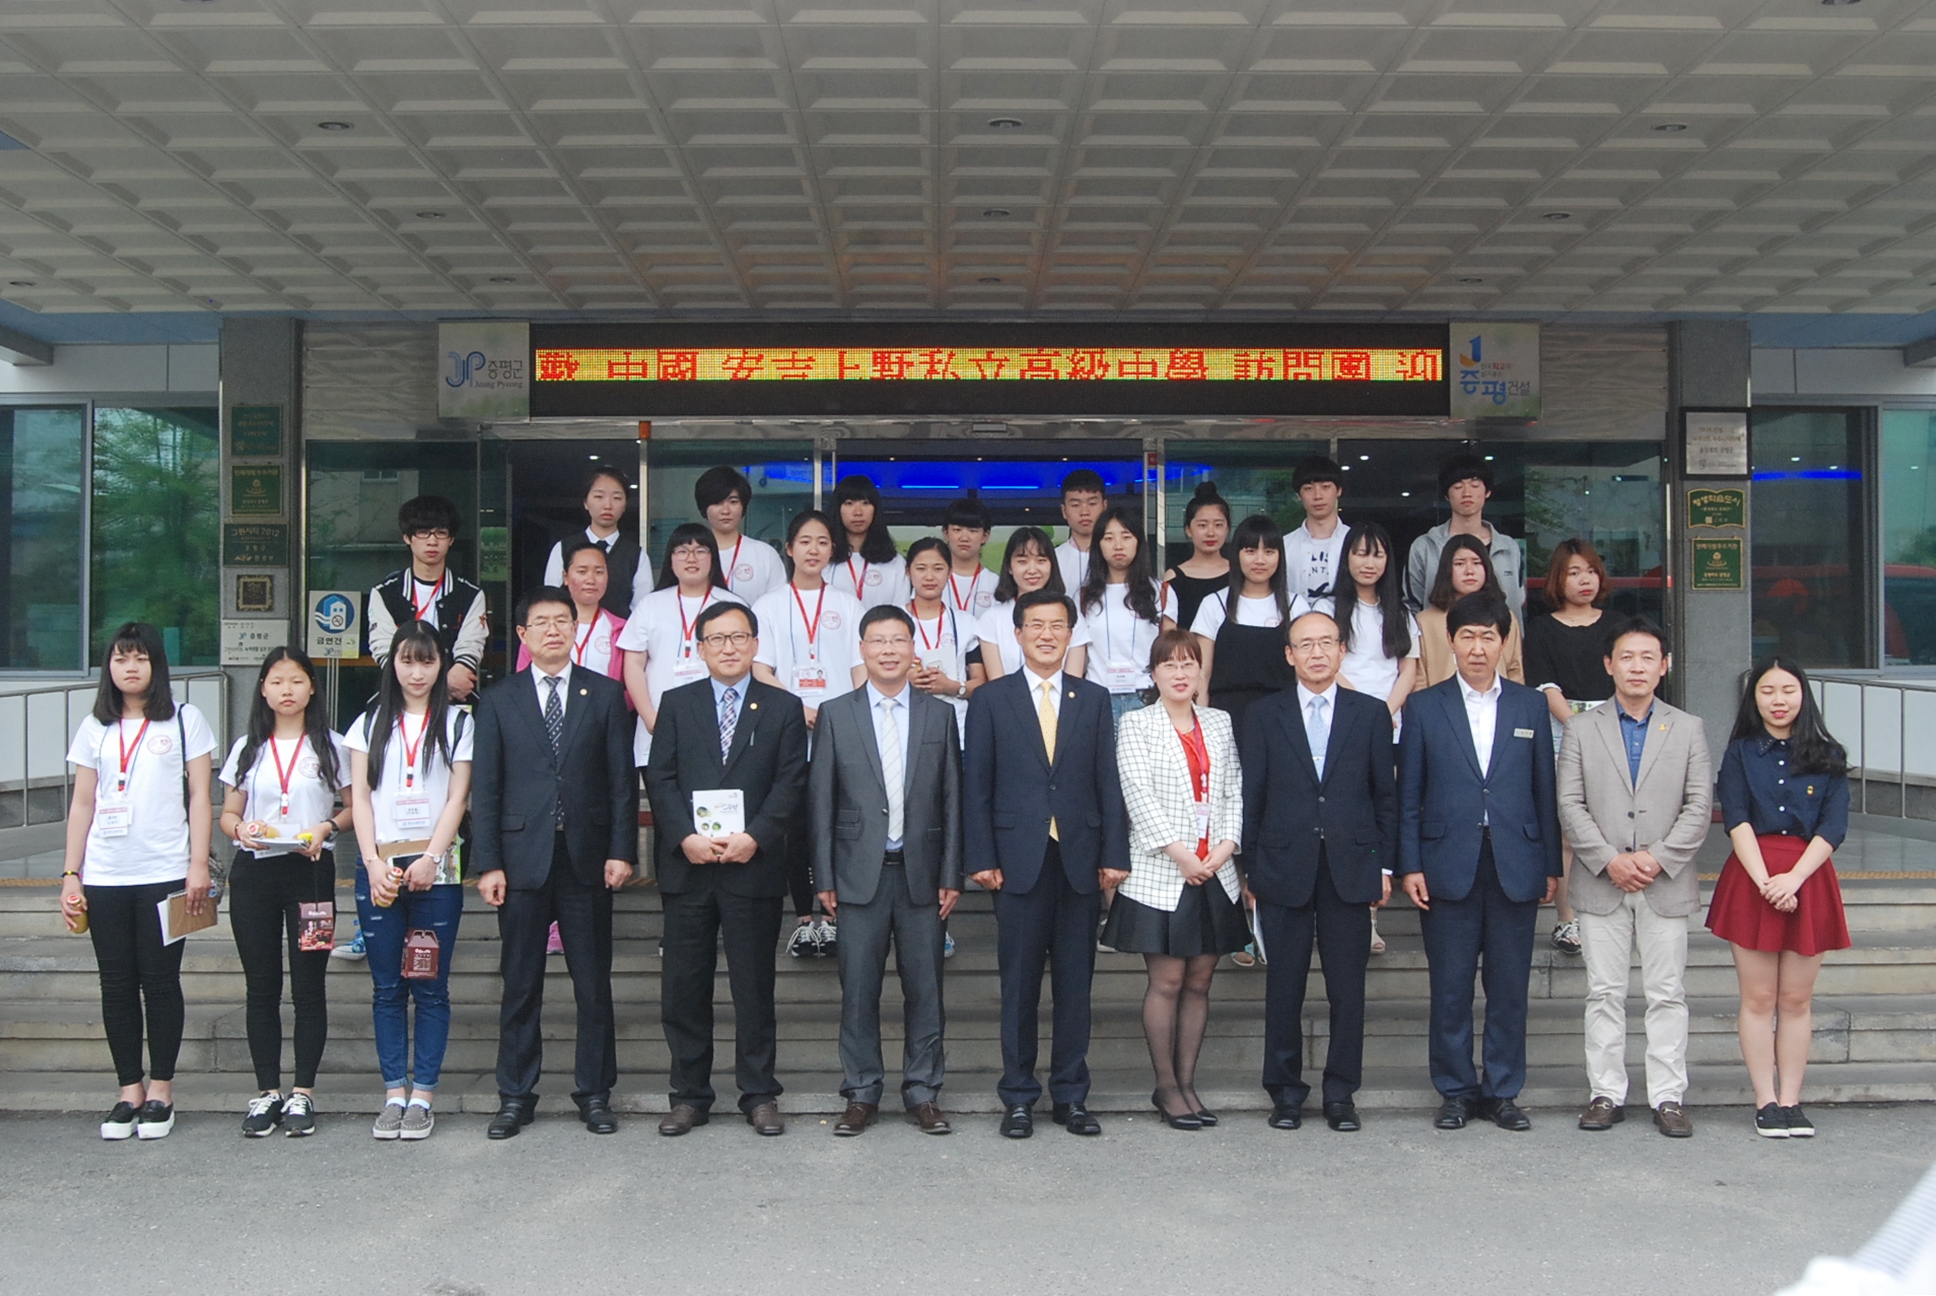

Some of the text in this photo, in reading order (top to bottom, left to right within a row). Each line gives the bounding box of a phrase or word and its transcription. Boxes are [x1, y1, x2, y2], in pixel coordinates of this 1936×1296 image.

[488, 360, 523, 379] 증평군
[262, 527, 280, 537] 2012
[317, 637, 342, 645] 금연건
